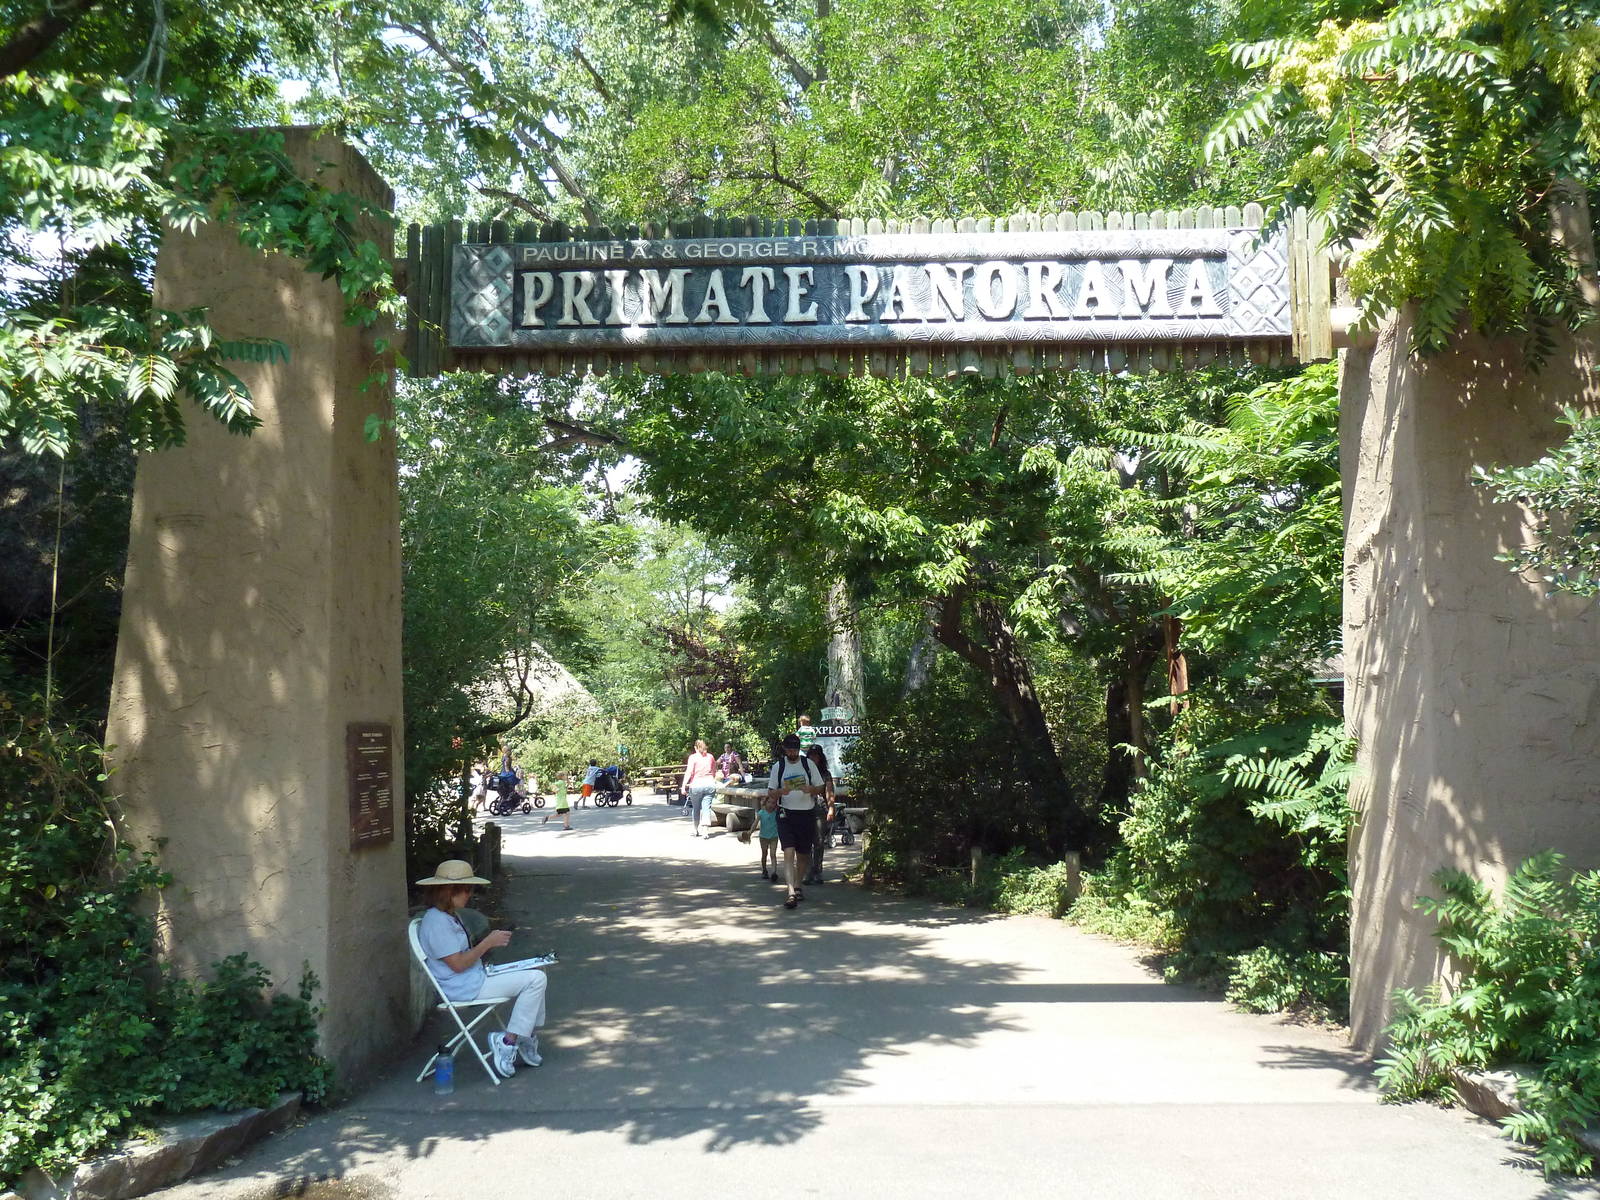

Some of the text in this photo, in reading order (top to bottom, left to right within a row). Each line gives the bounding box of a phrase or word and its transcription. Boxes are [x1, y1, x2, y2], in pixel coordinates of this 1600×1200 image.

[523, 245, 624, 261] PAULINE
[631, 245, 653, 259] A.
[661, 244, 678, 259] &
[685, 241, 789, 258] GEORGE
[802, 241, 825, 256] R.
[520, 259, 1223, 327] PRIMATE PANORAMA
